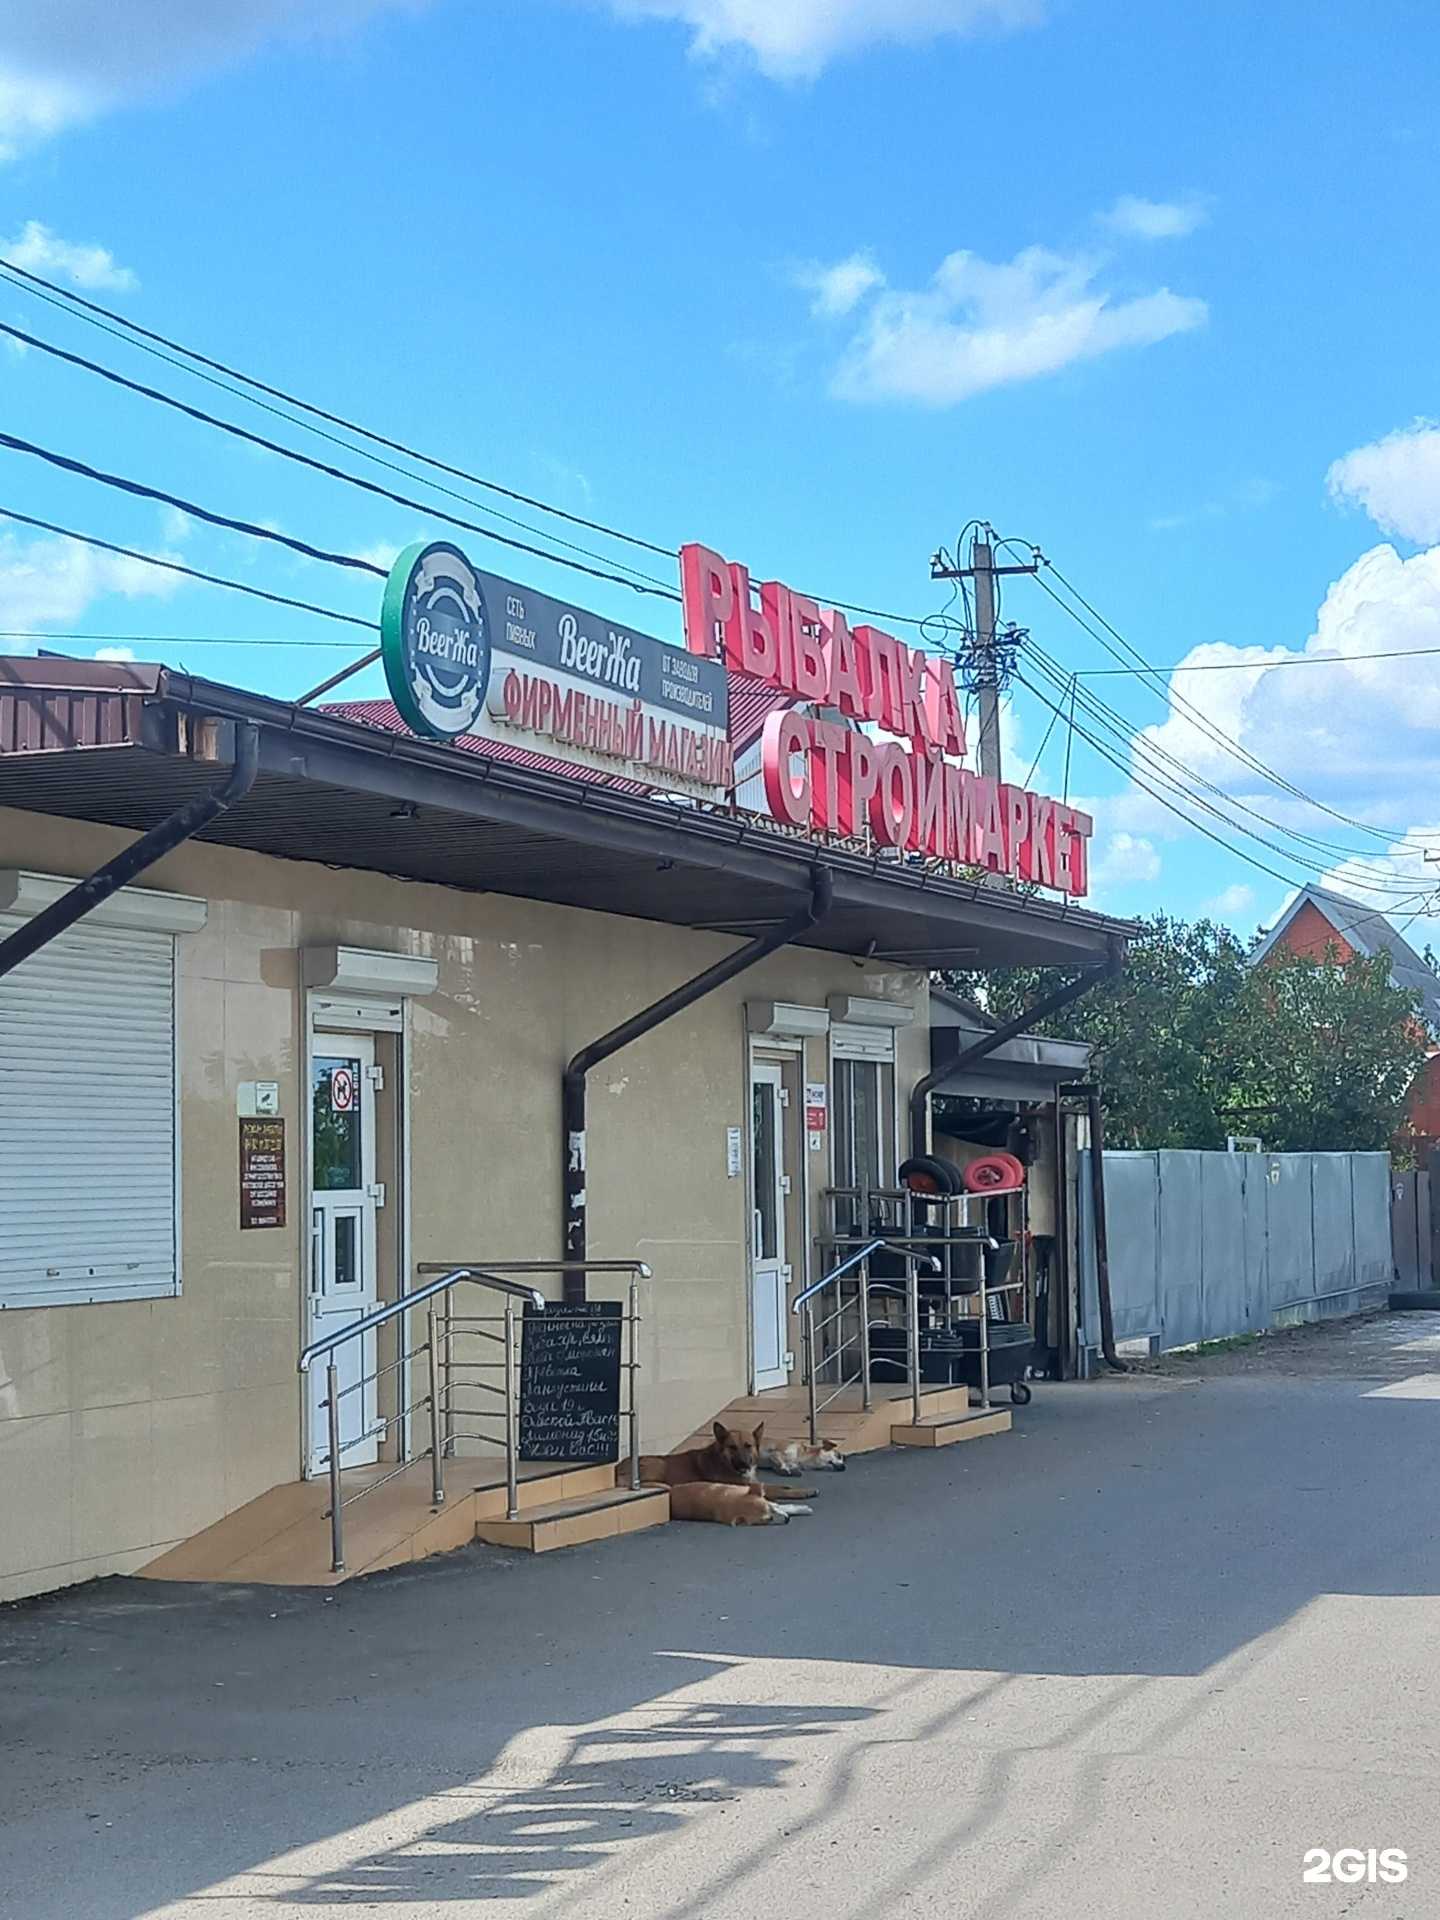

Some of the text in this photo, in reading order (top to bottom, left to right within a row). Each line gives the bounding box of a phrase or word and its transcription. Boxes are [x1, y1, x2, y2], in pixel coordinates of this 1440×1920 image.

[506, 595, 525, 620] СЕТЬ
[662, 654, 671, 673] ОТ
[681, 543, 967, 756] РЫБАЛКА
[504, 667, 734, 788] ФИРМЕННЫЙ МАГАЗИН
[762, 709, 1094, 897] СТРОЙМАРКЕТ
